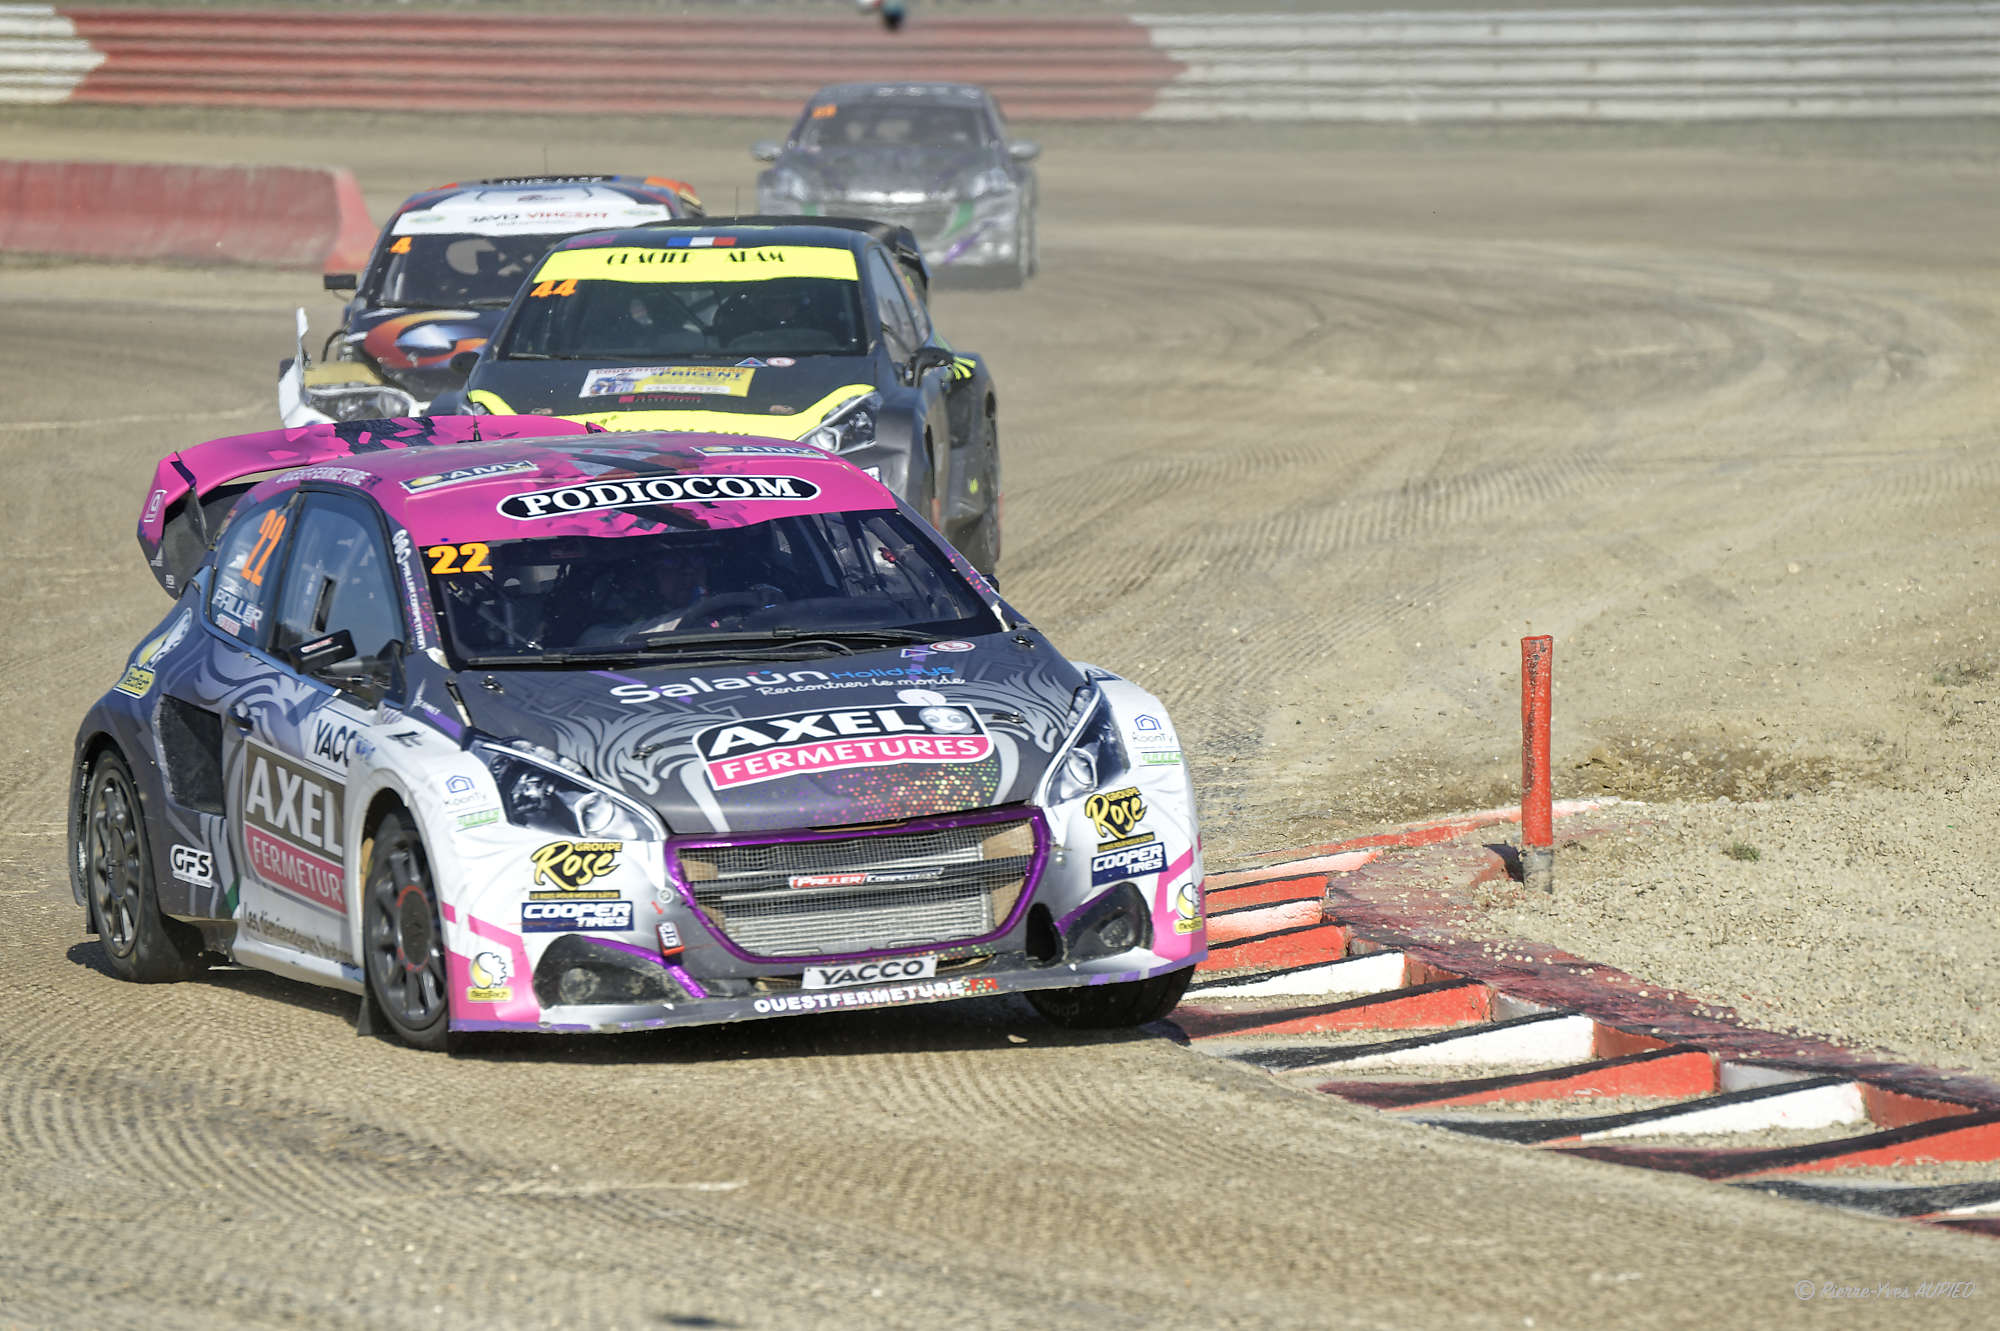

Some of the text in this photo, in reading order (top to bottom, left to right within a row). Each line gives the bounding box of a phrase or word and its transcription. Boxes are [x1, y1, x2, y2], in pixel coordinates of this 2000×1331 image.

[389, 237, 412, 254] 4
[530, 279, 578, 297] 44
[450, 459, 527, 479] AMY
[523, 476, 801, 516] PODIOCOM
[240, 509, 287, 587] 22
[428, 542, 493, 574] 22
[609, 665, 956, 704] Salaün Holidays
[756, 675, 966, 697] Rencontrer le monde
[314, 718, 357, 768] YACC
[709, 709, 925, 757] AXEL
[720, 738, 980, 781] FERMETURES
[246, 757, 344, 857] AXEL
[1105, 787, 1142, 802] GROUPE
[1085, 793, 1148, 839] Rose
[574, 841, 622, 852] GROUPE
[1092, 843, 1164, 872] COOPER
[175, 848, 209, 877] GFS
[252, 836, 345, 903] FERMETUR
[531, 840, 621, 891] Rose
[1126, 859, 1164, 874] TIRES
[523, 903, 632, 919] COOPER
[575, 917, 630, 928] TIRES
[819, 960, 924, 985] YACCO
[753, 977, 999, 1013] OUESTFERMETURE.FR
